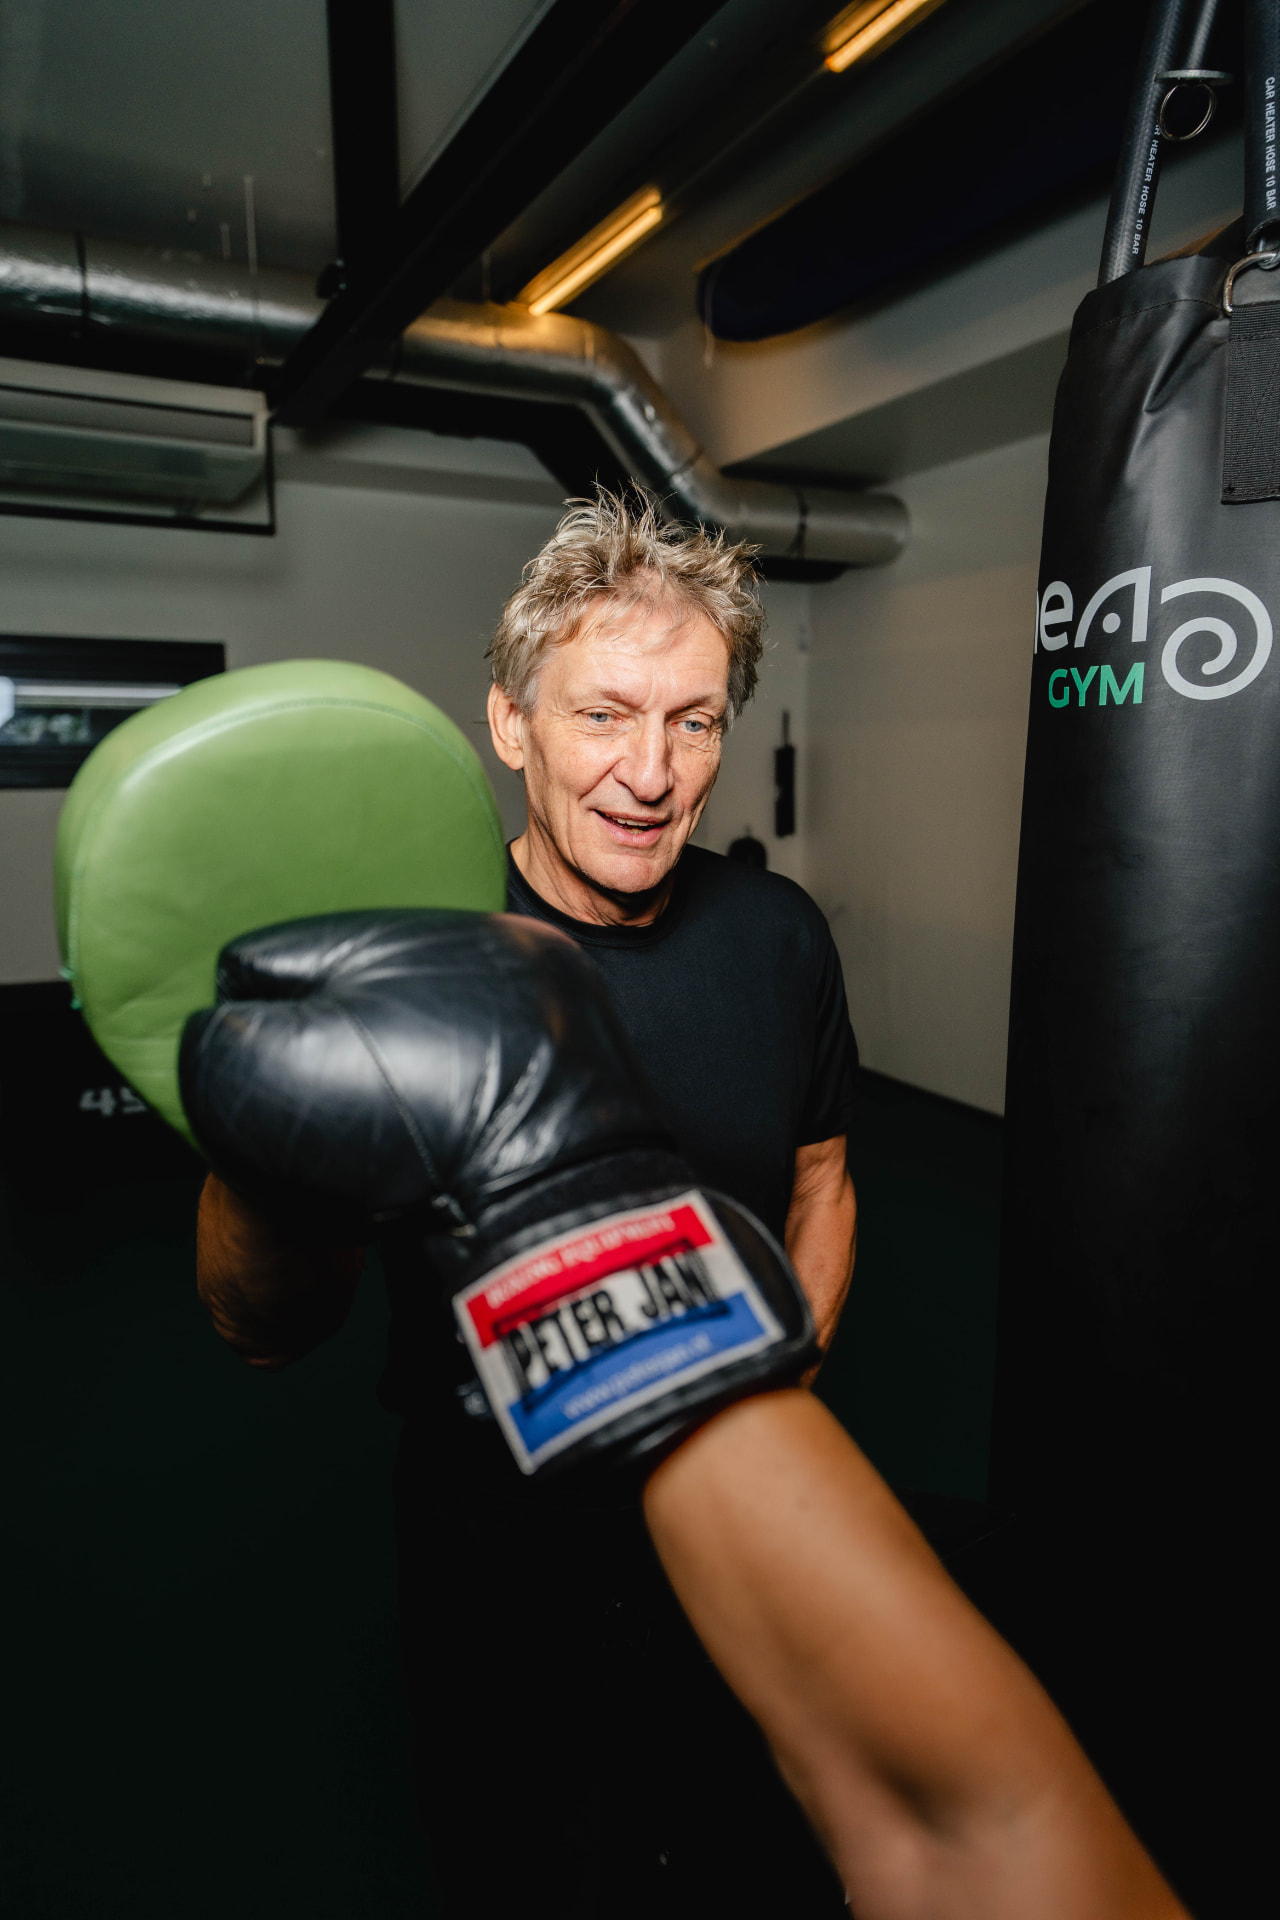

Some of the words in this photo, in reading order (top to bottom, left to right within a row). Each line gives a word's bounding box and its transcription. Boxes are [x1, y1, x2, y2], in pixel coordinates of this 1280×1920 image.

[1265, 76, 1275, 100] CAR
[1265, 101, 1276, 143] HEATER
[1144, 139, 1159, 182] HEATER
[1265, 144, 1276, 174] HOSE
[1265, 175, 1276, 187] 10
[1138, 185, 1150, 215] HOSE
[1266, 188, 1277, 211] BAR
[1135, 218, 1144, 231] 10
[1131, 233, 1142, 255] BAR
[1048, 662, 1145, 709] GYM
[499, 1289, 627, 1400] PETER
[639, 1246, 719, 1320] JAN
